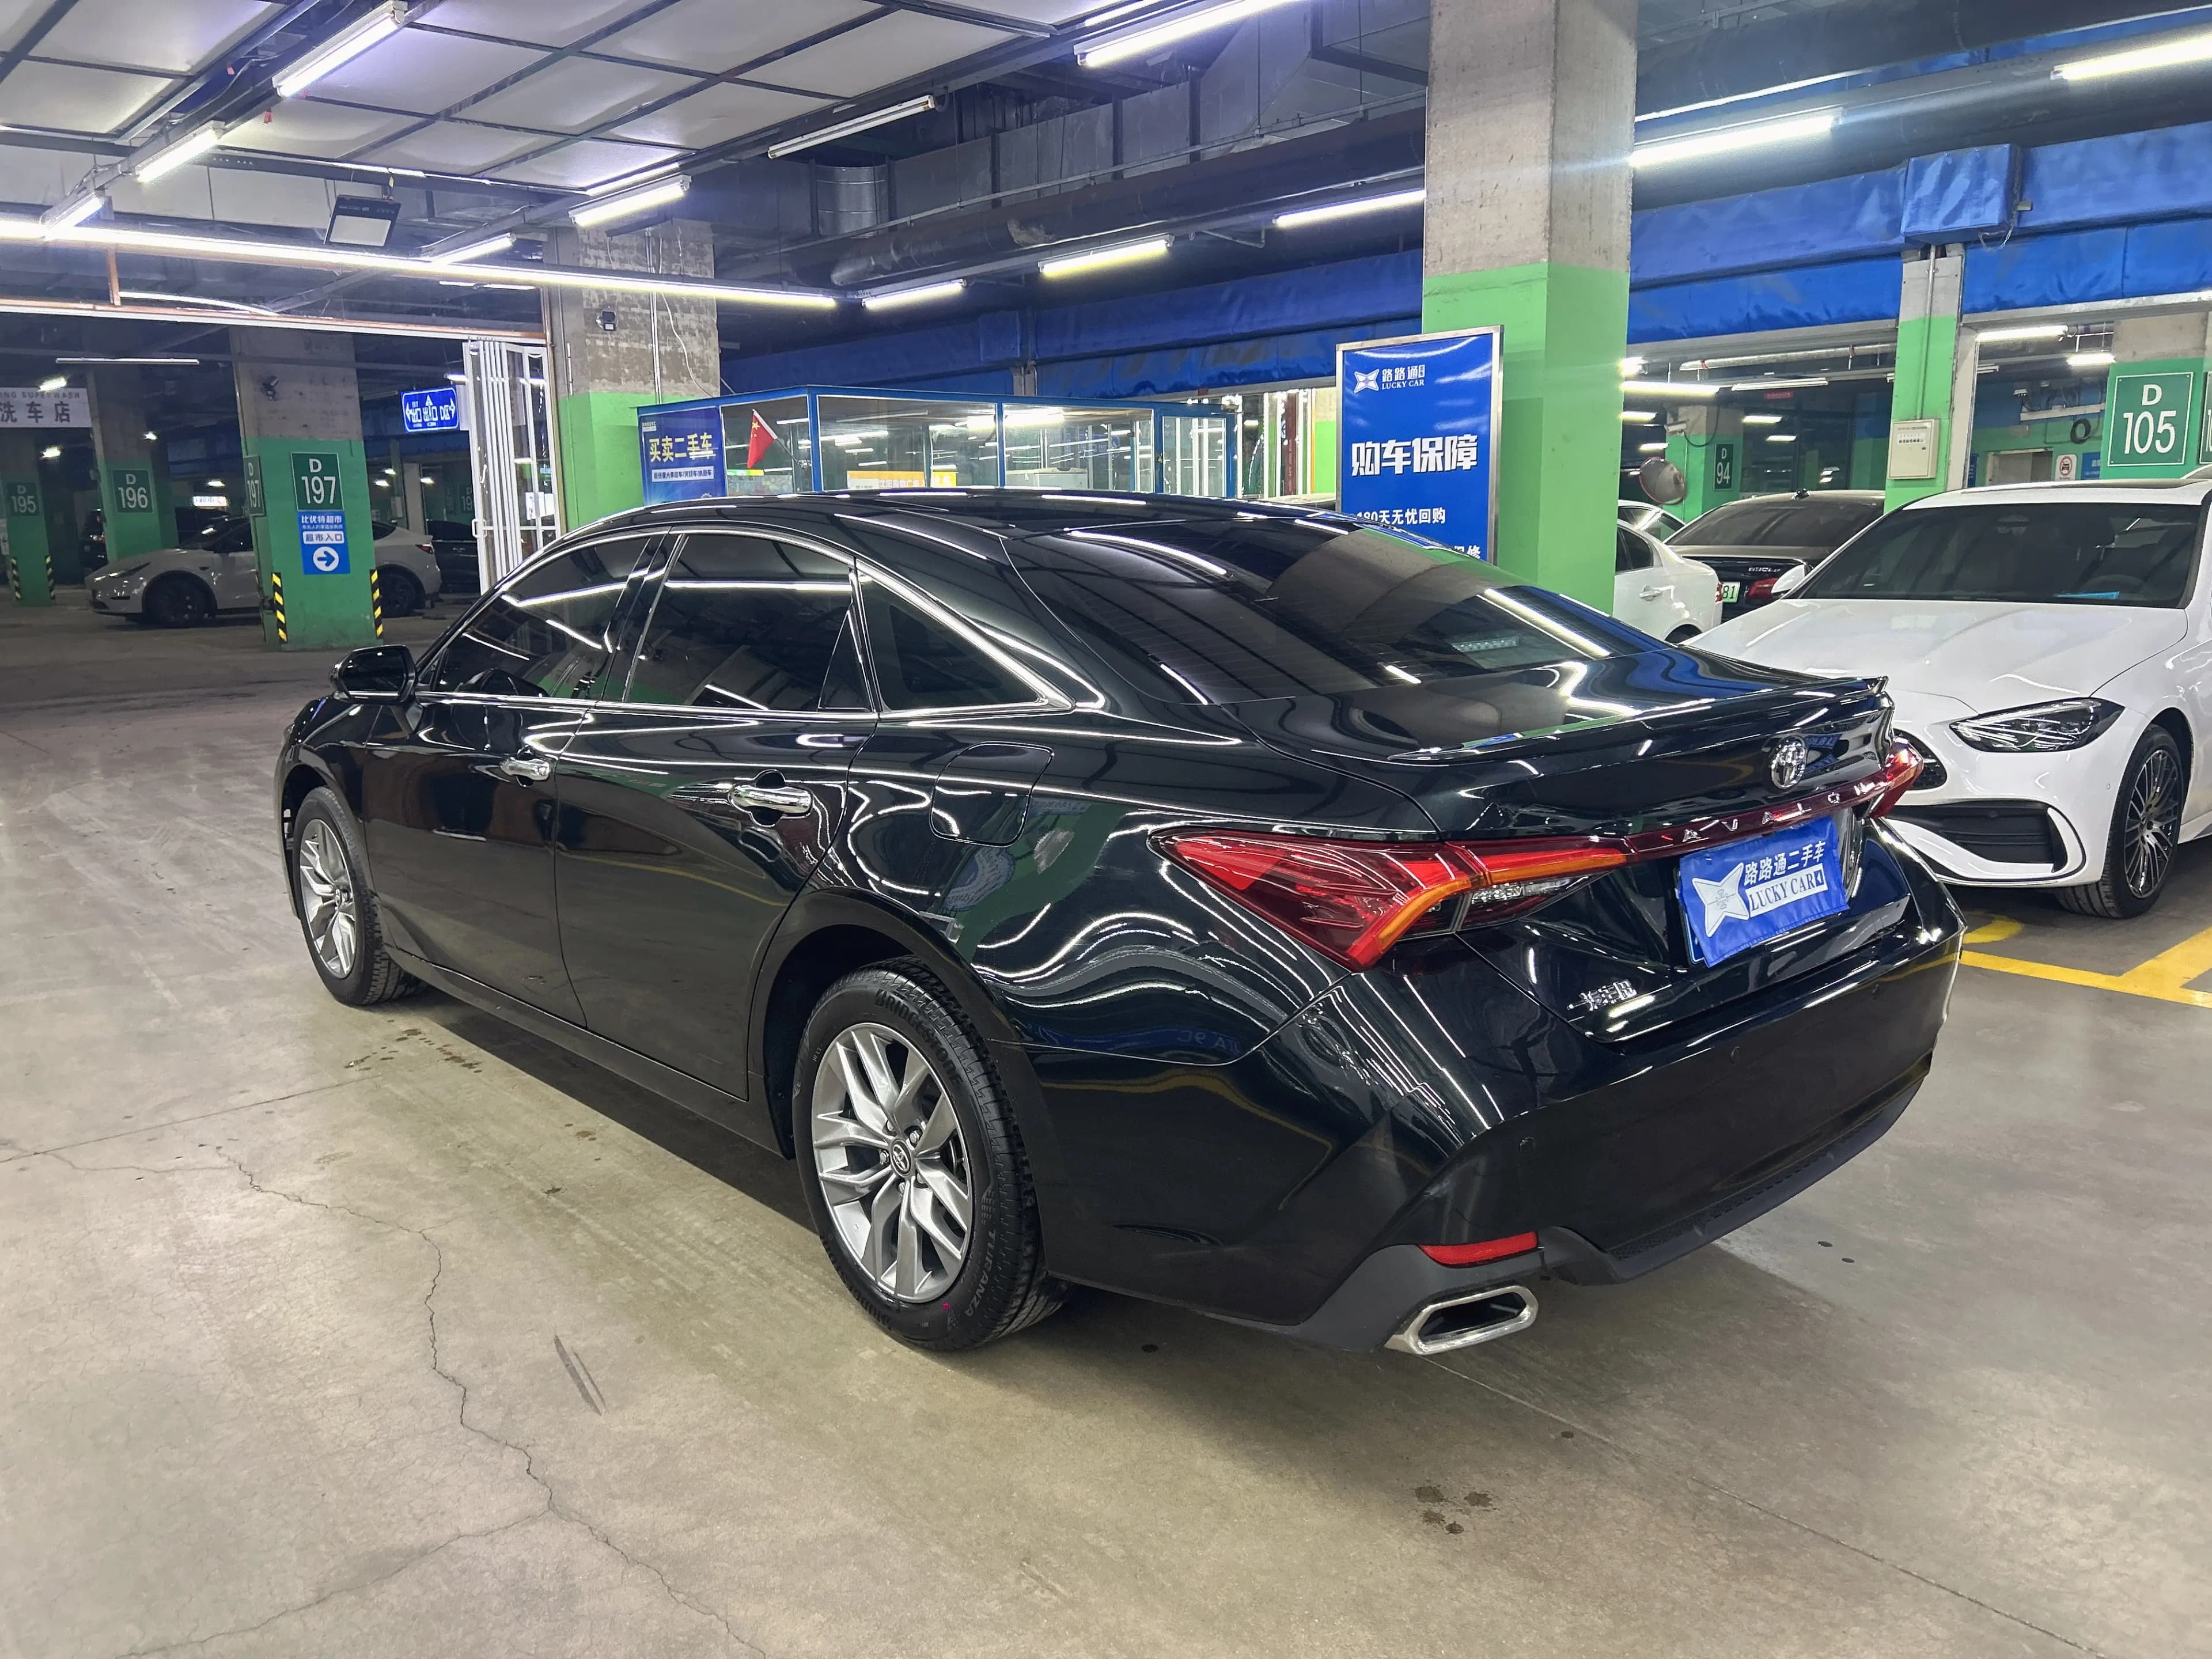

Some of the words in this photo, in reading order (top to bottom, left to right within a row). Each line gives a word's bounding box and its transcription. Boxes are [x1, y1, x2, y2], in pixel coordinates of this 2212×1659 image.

[1382, 381, 1407, 389] LUCKY
[1408, 379, 1425, 387] CAR
[2142, 384, 2162, 406] D
[0, 401, 70, 423] 洗车店
[2123, 410, 2177, 454] 105
[649, 432, 714, 463] 买卖二手车
[1351, 434, 1478, 476] 购车保障
[1722, 448, 1727, 459] D
[248, 463, 253, 476] D
[309, 459, 322, 473] D
[1717, 462, 1730, 484] 94
[17, 485, 26, 494] D
[126, 474, 137, 484] D
[301, 476, 336, 504] 197
[12, 496, 36, 513] 195
[118, 487, 148, 508] 196
[247, 480, 259, 507] 197
[461, 496, 474, 511] 19
[301, 516, 342, 524] 比优特超市
[306, 533, 343, 541] 超市入口
[1744, 840, 1826, 886] 路路通二手车
[1749, 881, 1787, 911] LUCKY
[1791, 873, 1815, 895] CAR
[874, 988, 964, 1084] BRIDGESTONE
[965, 1229, 996, 1317] TURANZA
